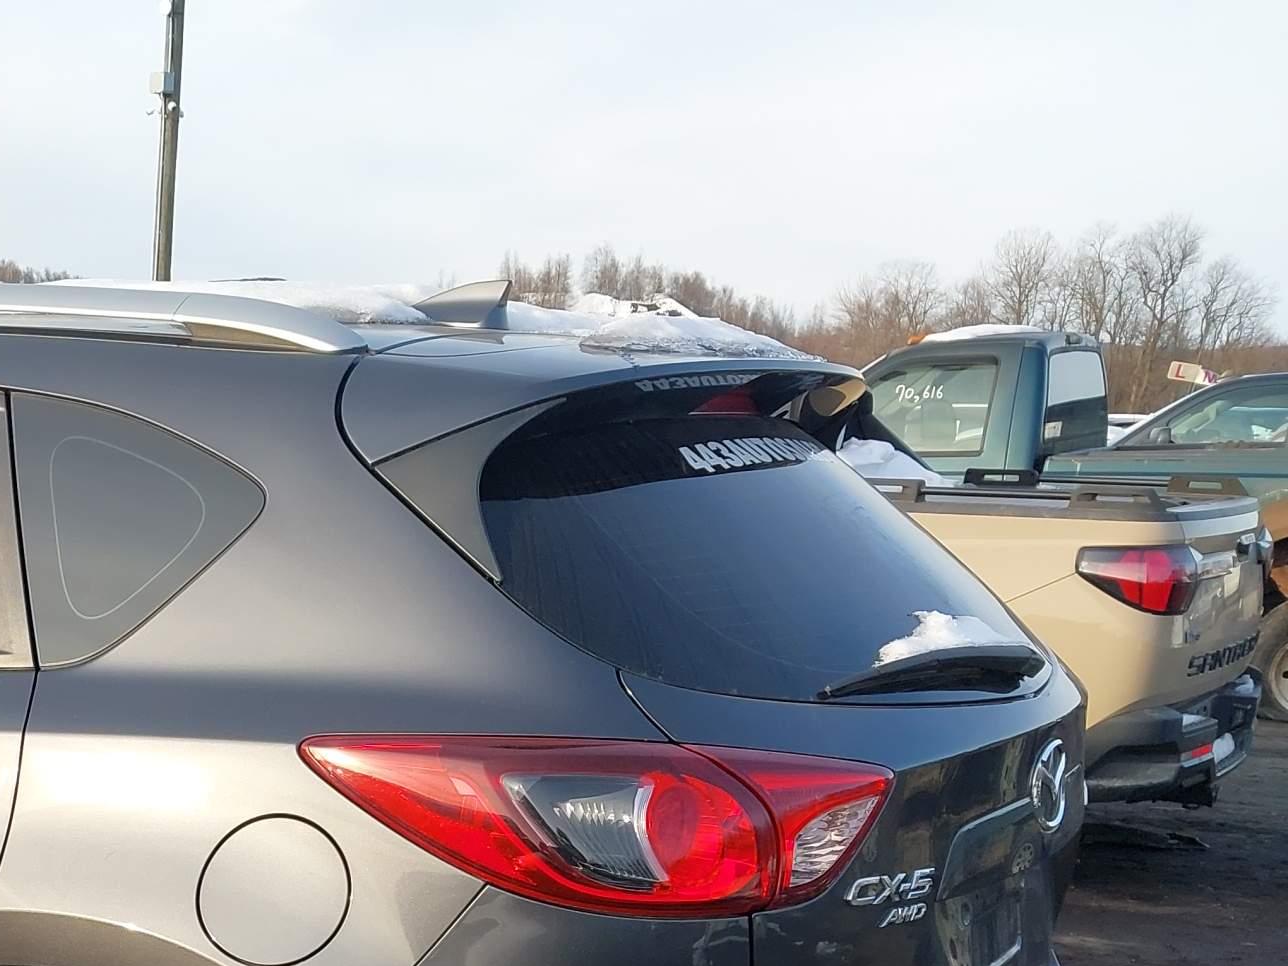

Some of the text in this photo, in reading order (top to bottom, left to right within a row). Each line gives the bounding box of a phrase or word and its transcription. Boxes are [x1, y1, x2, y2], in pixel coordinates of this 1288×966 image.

[896, 384, 944, 403] 70,616
[844, 867, 935, 906] CX-5
[878, 902, 927, 928] AWD
